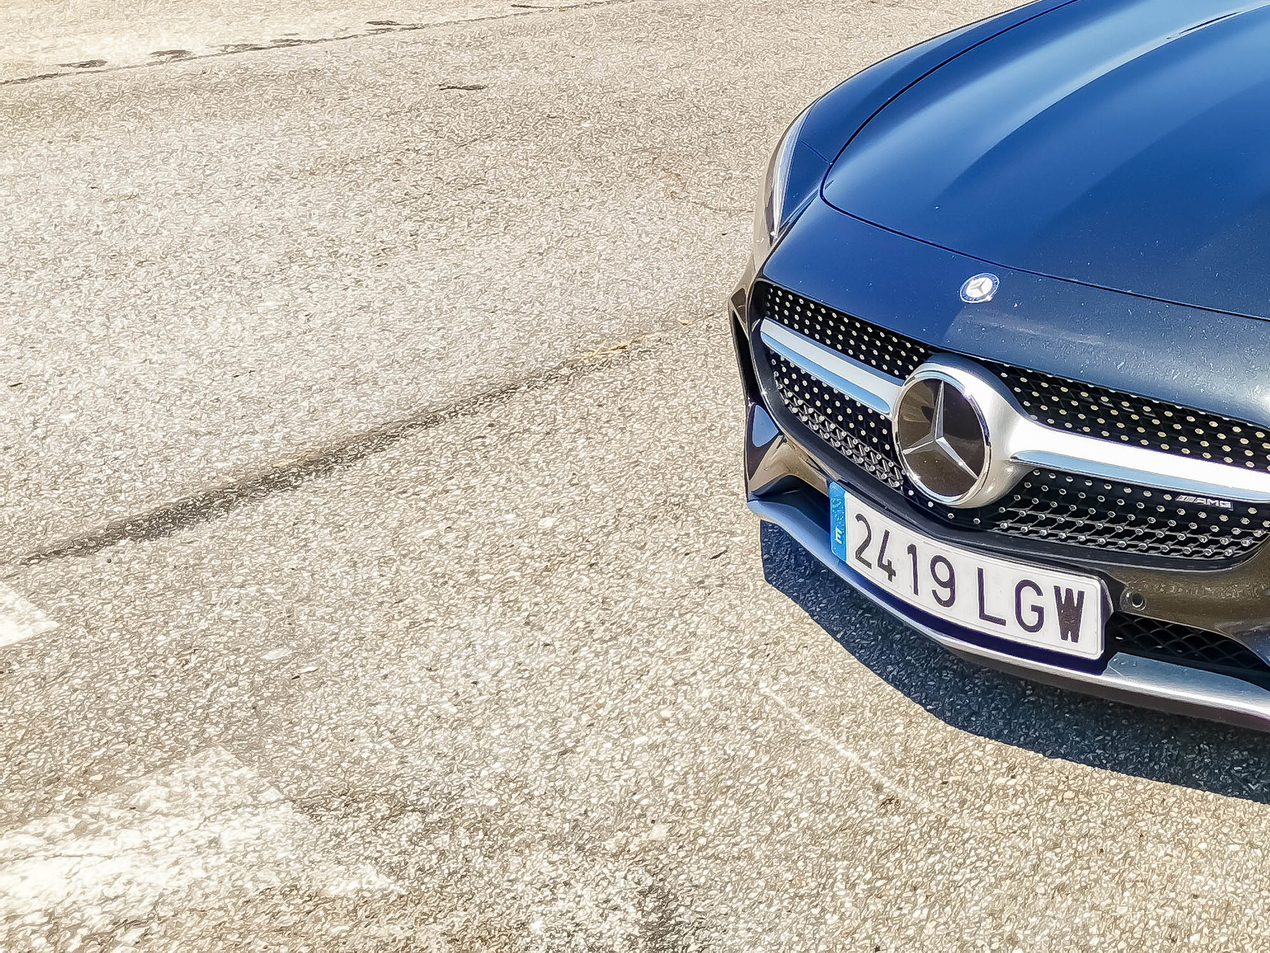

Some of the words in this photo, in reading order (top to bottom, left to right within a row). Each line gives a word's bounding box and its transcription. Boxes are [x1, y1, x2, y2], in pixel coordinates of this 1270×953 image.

[1194, 496, 1233, 511] AMG
[855, 513, 956, 608] 2419
[977, 566, 1085, 643] LGW
